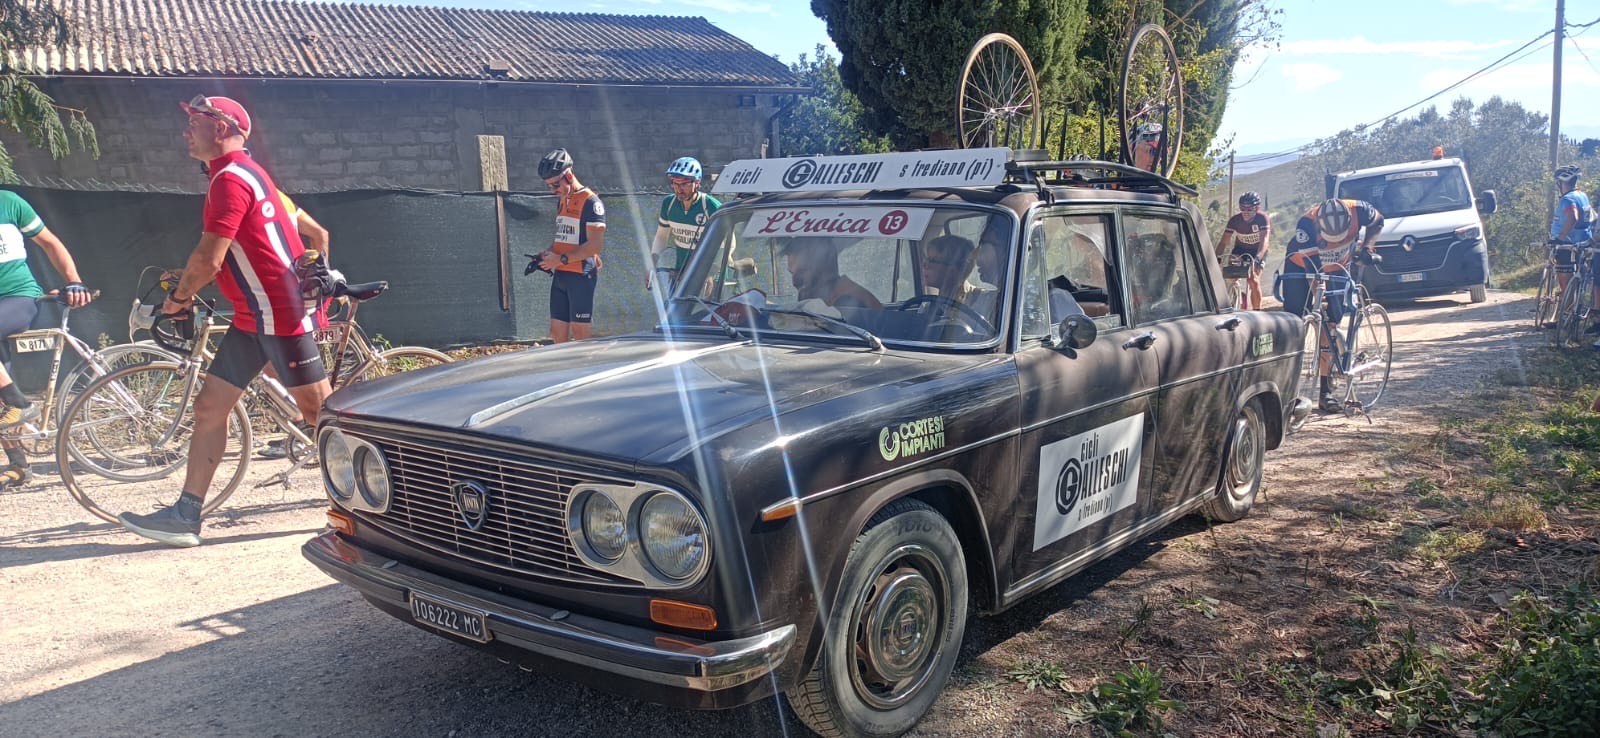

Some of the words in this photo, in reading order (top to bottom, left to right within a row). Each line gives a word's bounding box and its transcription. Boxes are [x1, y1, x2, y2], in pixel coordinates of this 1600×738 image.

[730, 166, 763, 185] cicli
[781, 159, 883, 189] GALLESCHI
[899, 164, 909, 178] s
[911, 158, 966, 177] frediano
[758, 210, 871, 234] L'Eroica
[884, 215, 903, 230] 13
[900, 416, 944, 439] CORTESI
[901, 432, 945, 457] IMPIANTI
[1080, 432, 1099, 461] cicli
[1056, 448, 1128, 515] GALLESCHI
[415, 599, 459, 630] 106222
[463, 615, 480, 636] MC
